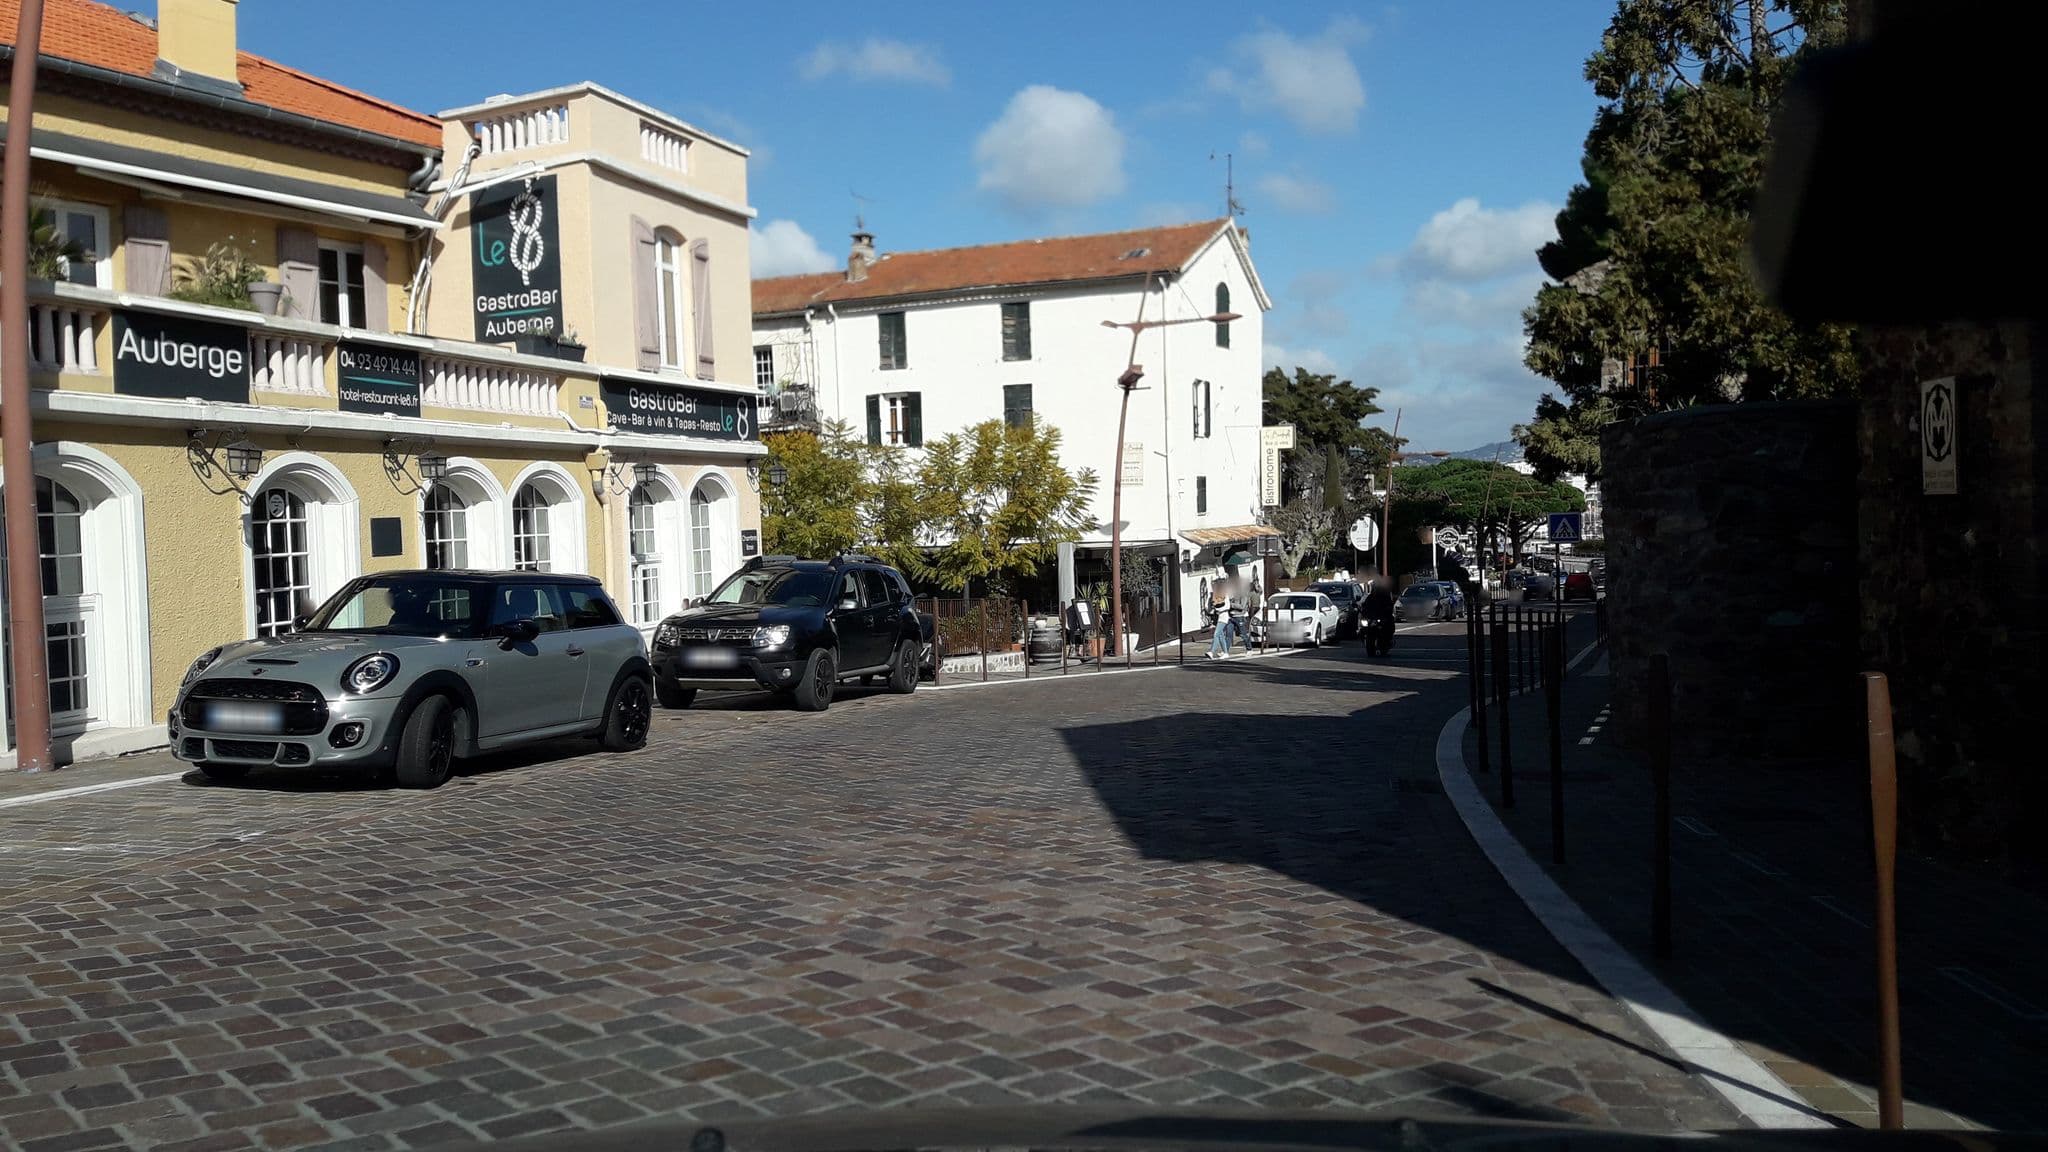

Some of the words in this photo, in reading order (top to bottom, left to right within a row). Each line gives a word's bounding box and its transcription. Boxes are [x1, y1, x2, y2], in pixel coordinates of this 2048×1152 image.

[476, 289, 558, 312] GastroBar
[117, 327, 243, 378] Auberge
[340, 350, 355, 368] 04
[358, 353, 372, 370] 93
[373, 355, 388, 372] 49
[390, 357, 401, 374] 14
[402, 359, 416, 376] 44
[340, 387, 418, 406] hotel-restaurant-le8.fr
[629, 387, 698, 414] GastroBar
[654, 415, 666, 427] vin
[667, 417, 673, 428] &
[1265, 447, 1275, 505] Bistronome
